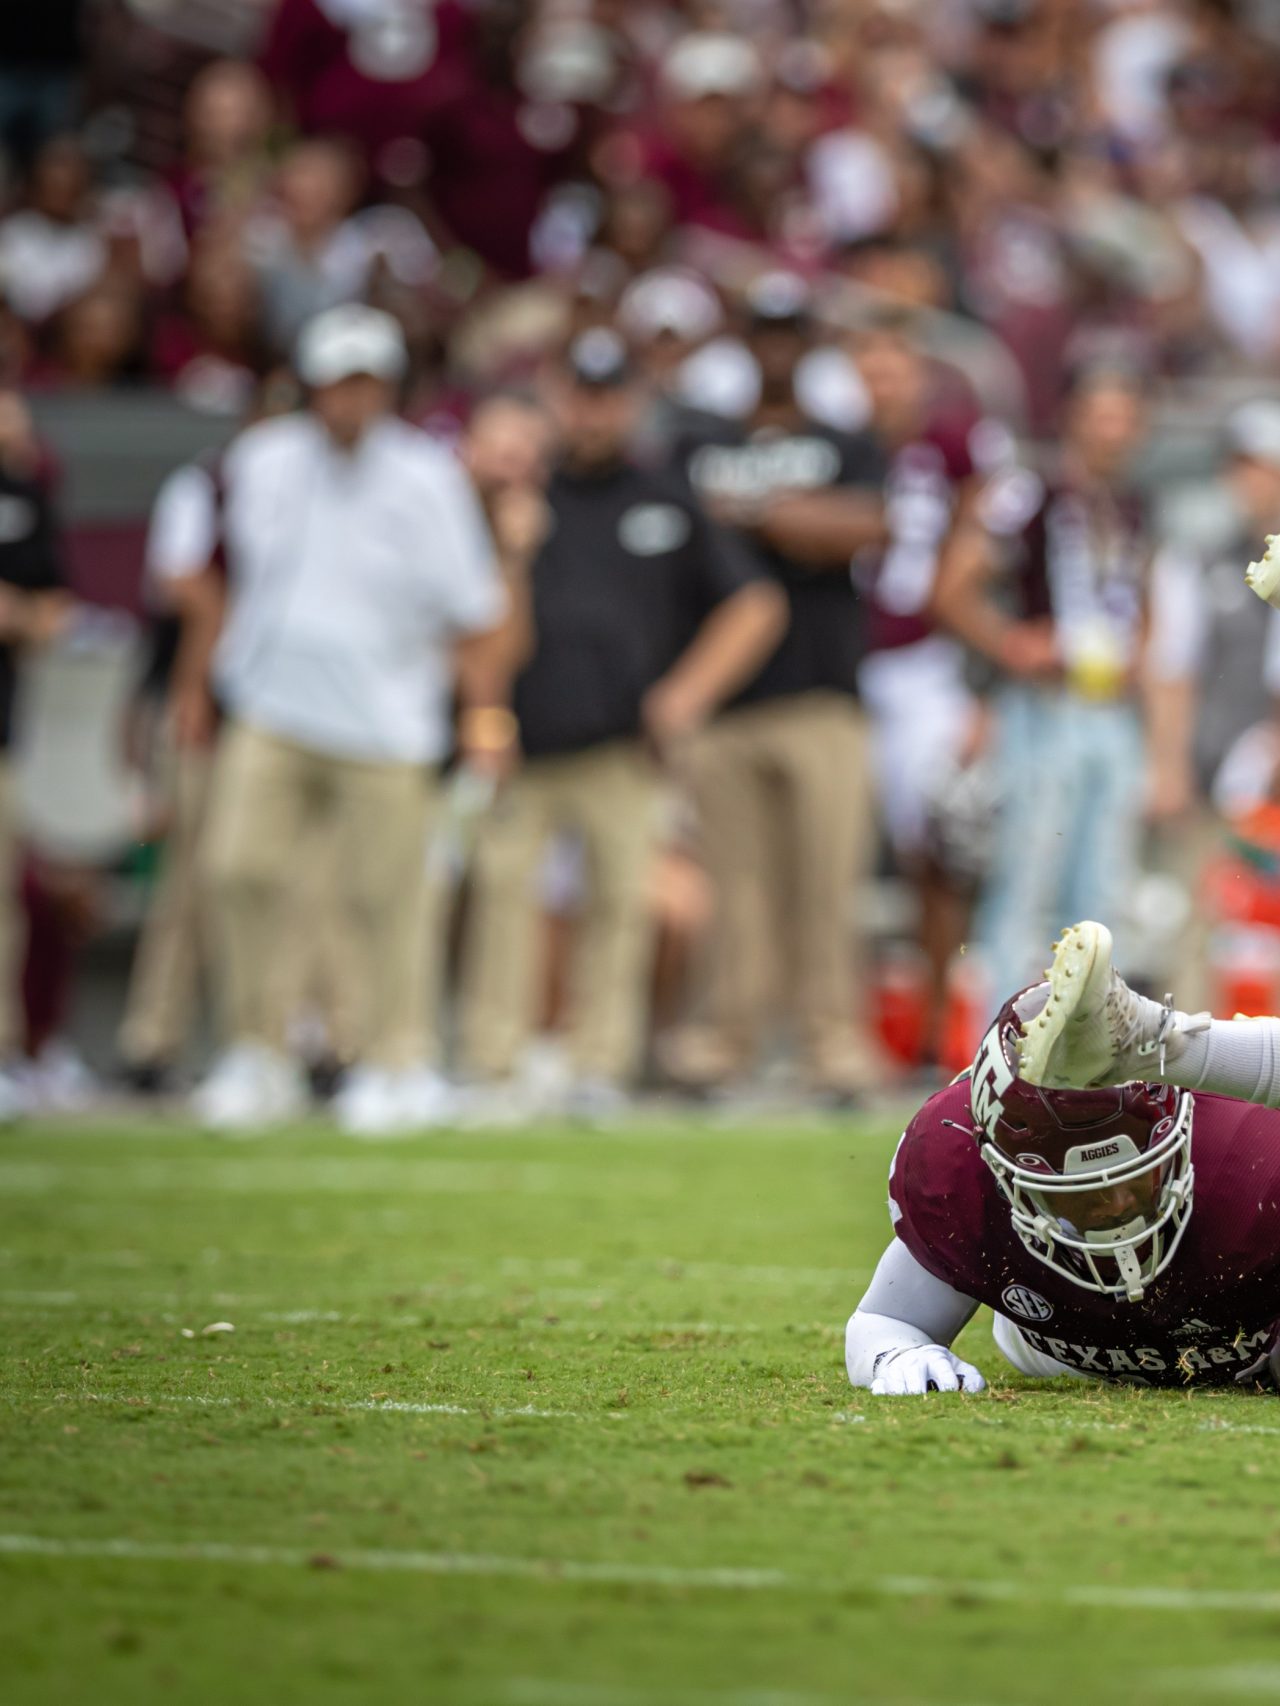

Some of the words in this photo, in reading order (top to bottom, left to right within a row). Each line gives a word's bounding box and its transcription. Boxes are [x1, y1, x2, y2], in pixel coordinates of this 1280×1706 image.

[1080, 1142, 1119, 1162] AGGIES
[1006, 1288, 1049, 1319] SEC
[1017, 1326, 1166, 1372] TEXAS
